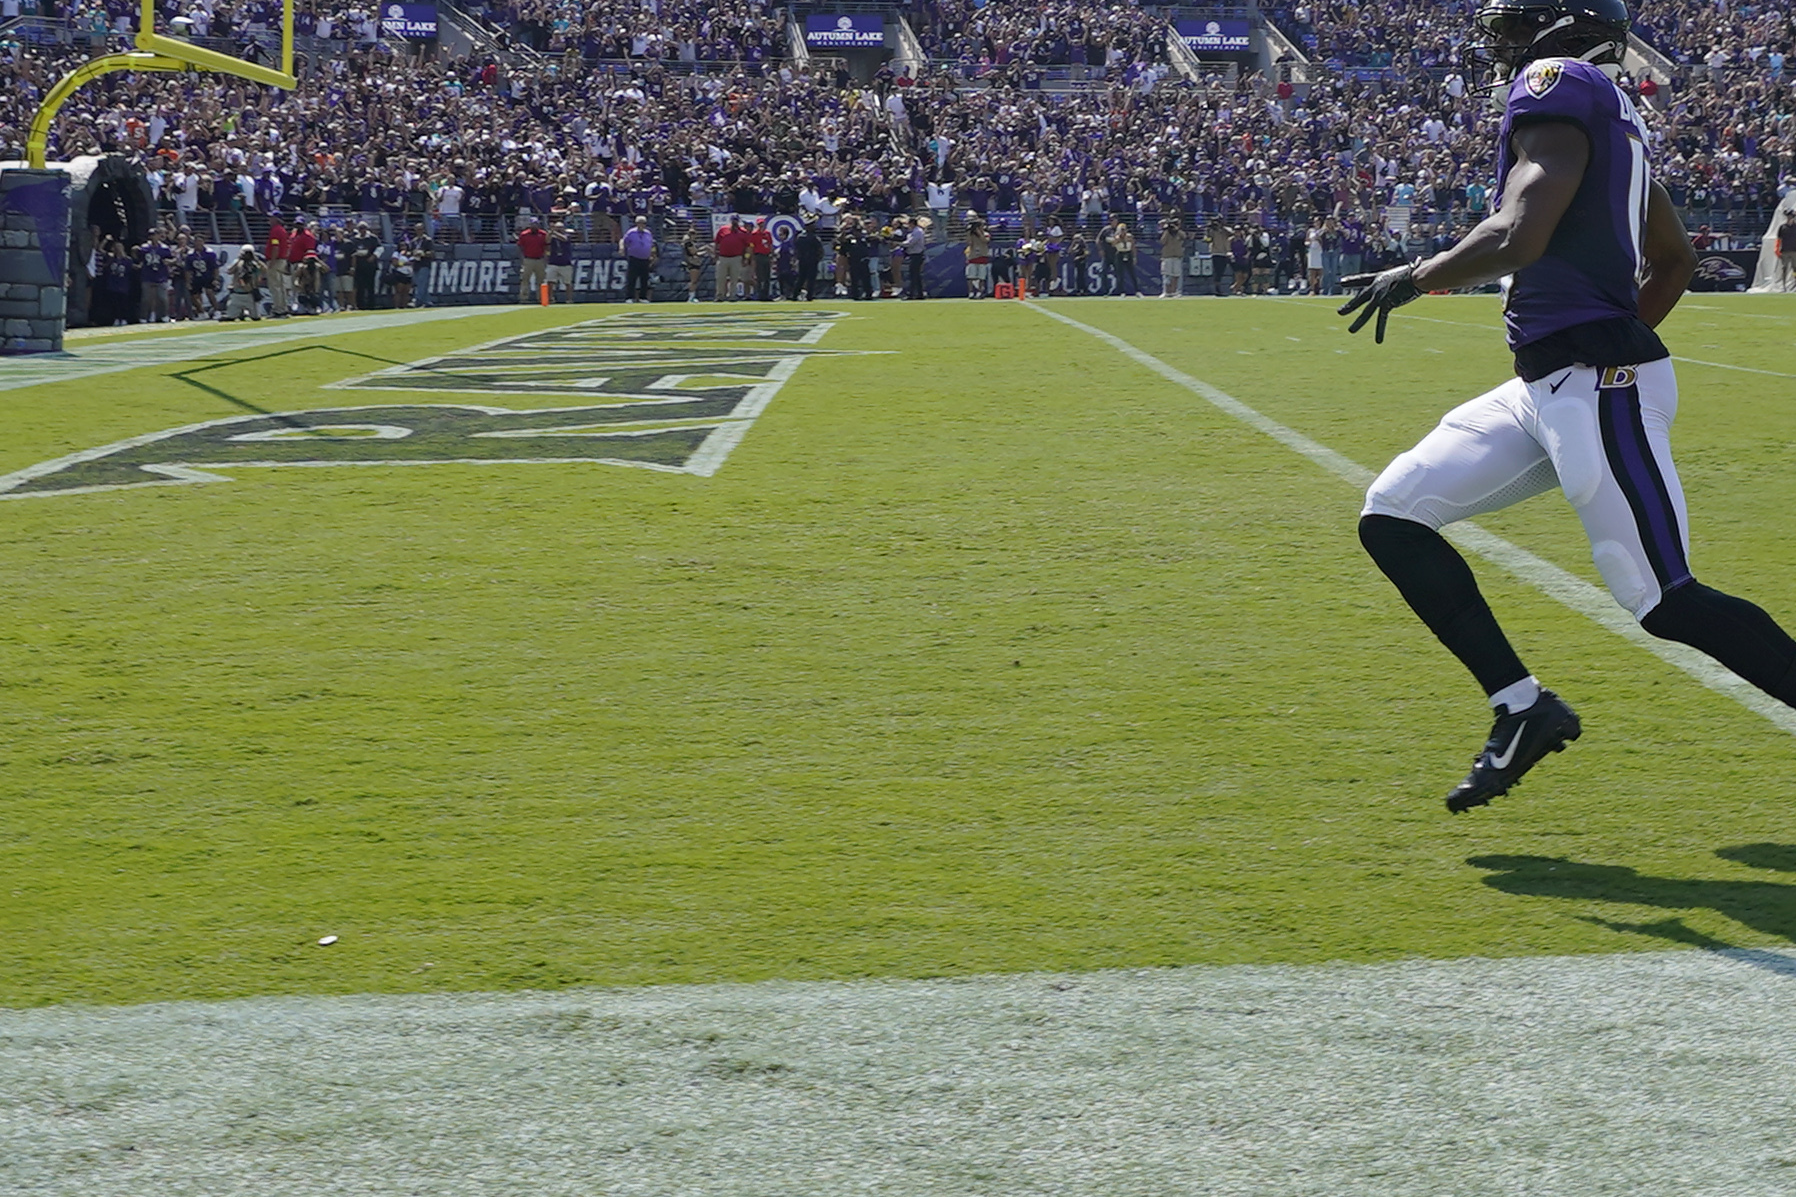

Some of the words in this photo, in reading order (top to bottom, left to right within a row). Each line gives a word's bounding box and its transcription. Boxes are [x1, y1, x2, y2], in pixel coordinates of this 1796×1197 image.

[406, 21, 437, 33] LAKE
[807, 31, 855, 41] AUTUMN
[855, 31, 884, 41] LAKE
[1222, 36, 1250, 46] LAKE
